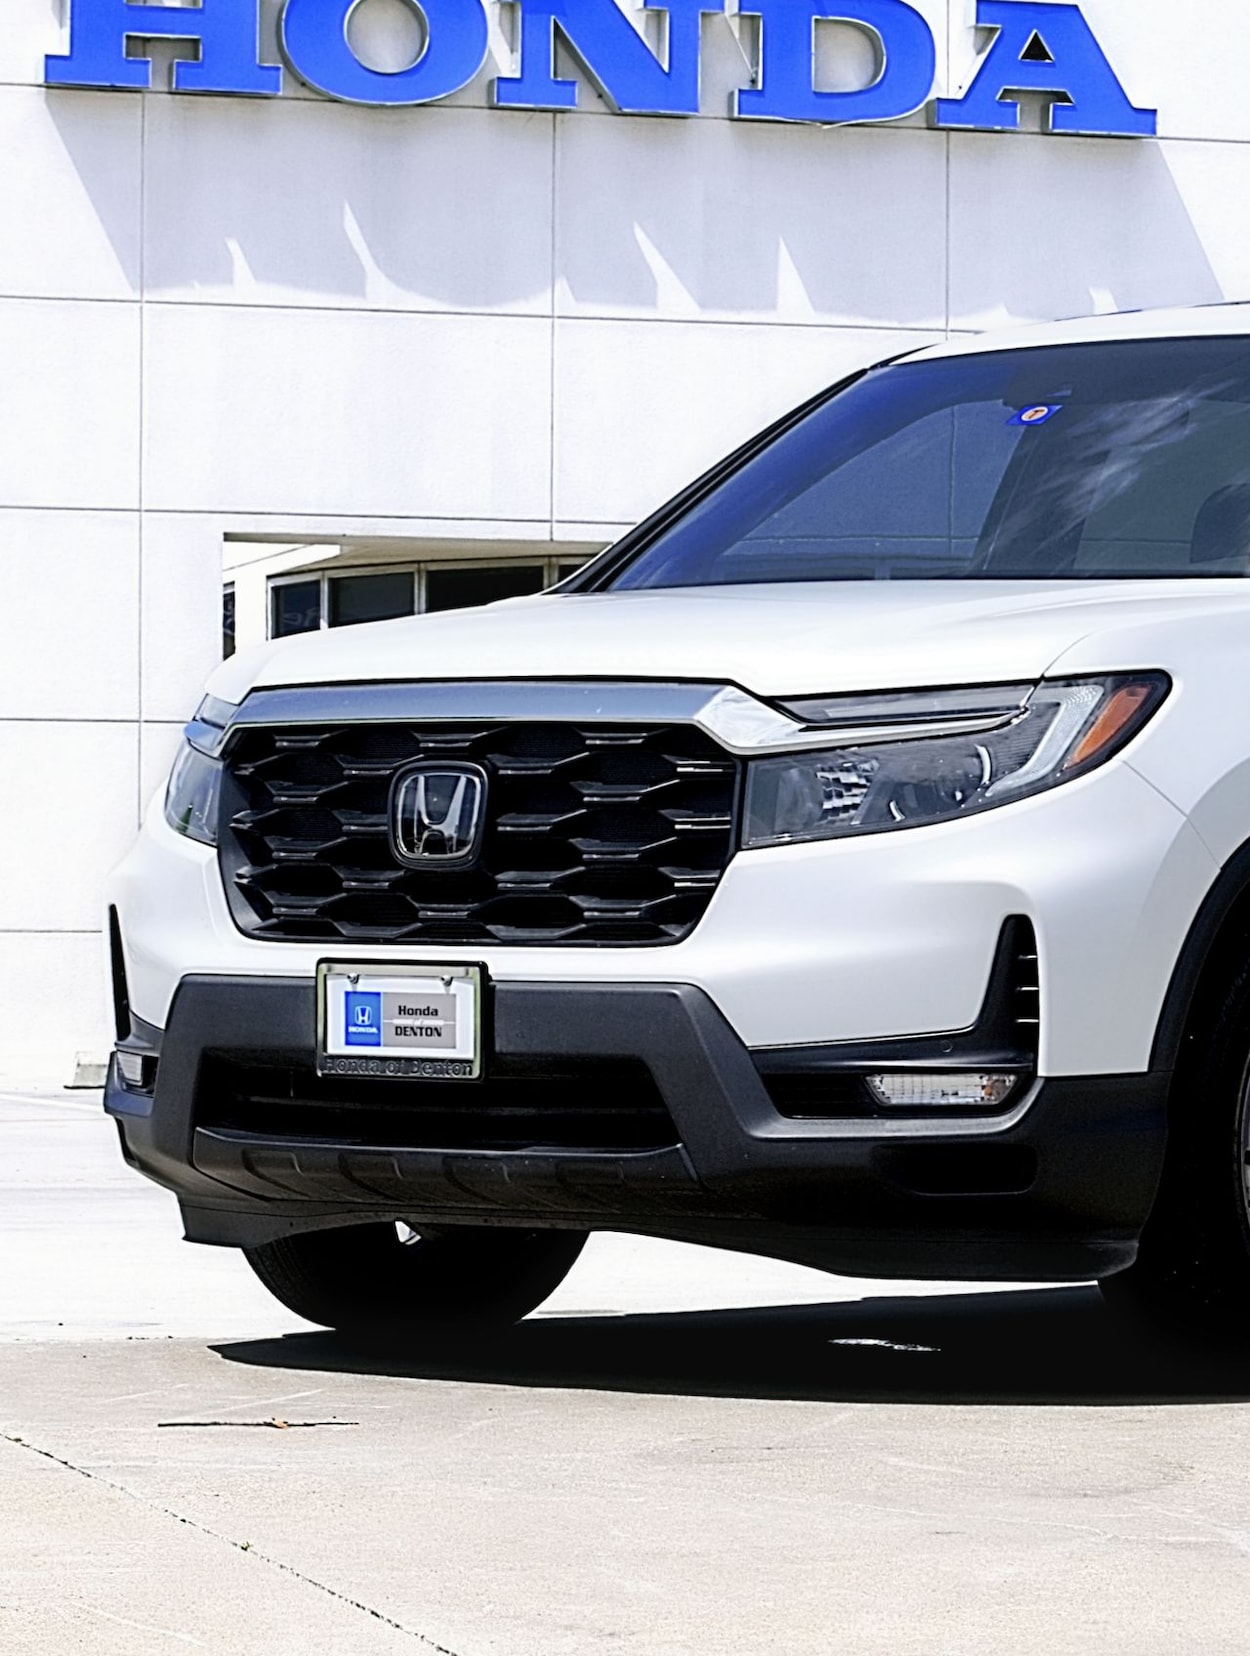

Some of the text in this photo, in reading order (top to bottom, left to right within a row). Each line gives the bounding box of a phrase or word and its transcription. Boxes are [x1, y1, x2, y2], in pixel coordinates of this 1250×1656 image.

[45, 0, 1158, 136] HONDA
[398, 1005, 439, 1017] Honda
[394, 1026, 442, 1037] DENTON
